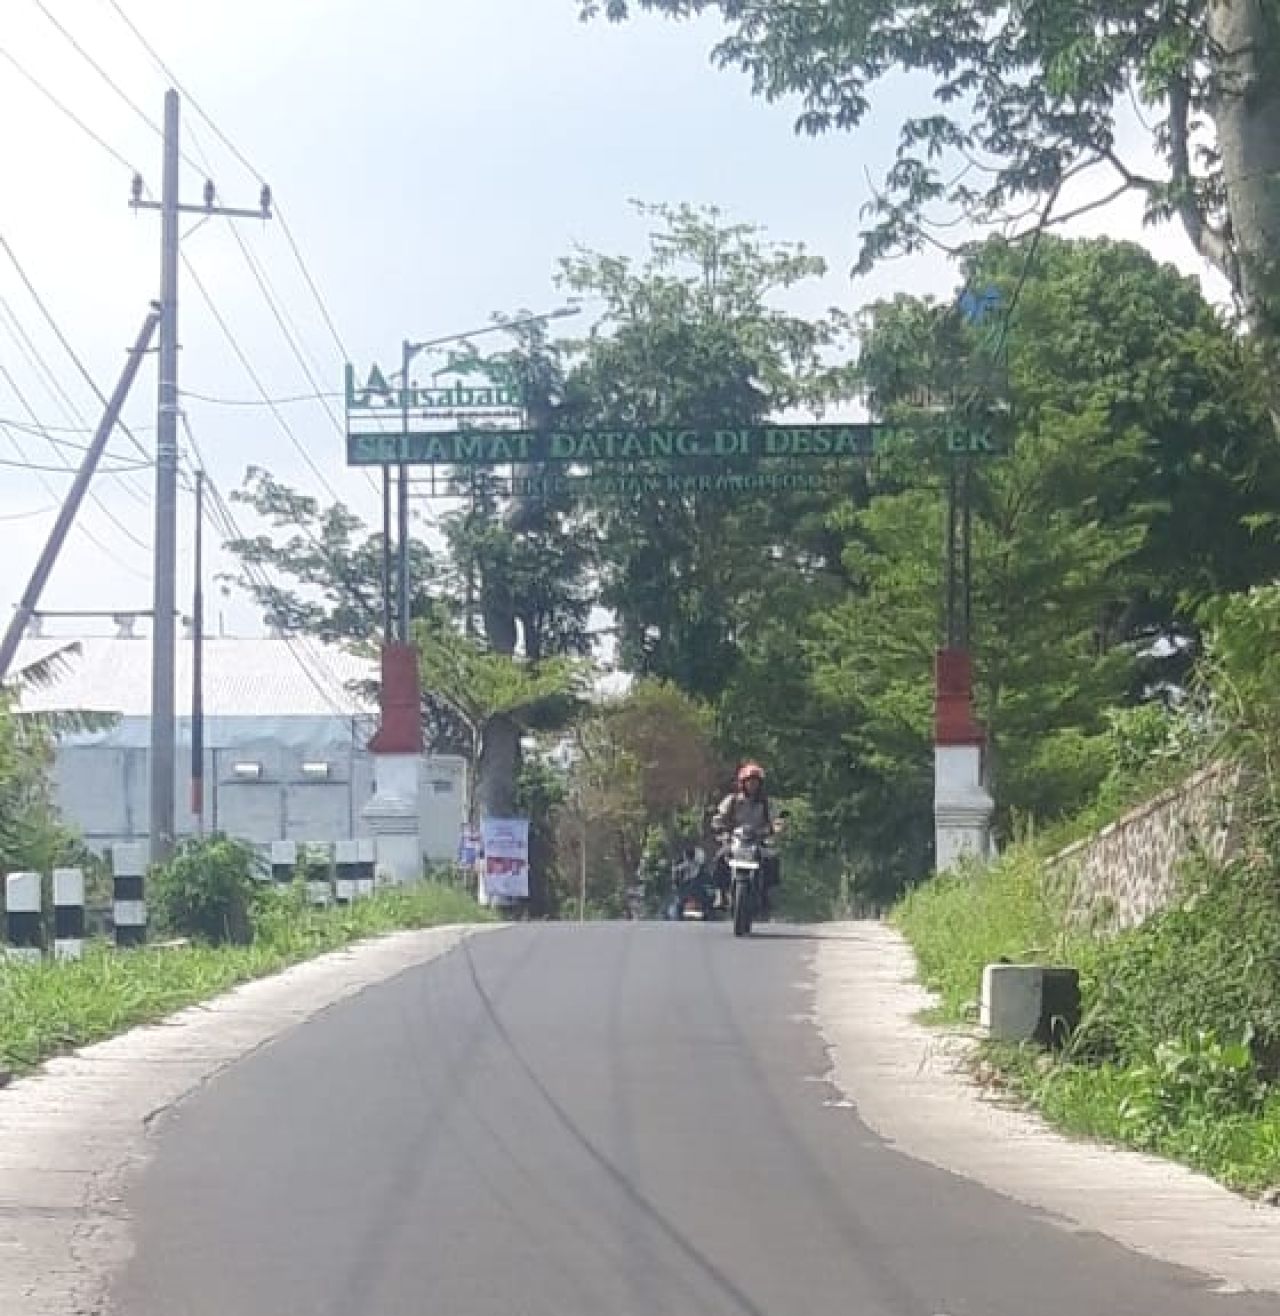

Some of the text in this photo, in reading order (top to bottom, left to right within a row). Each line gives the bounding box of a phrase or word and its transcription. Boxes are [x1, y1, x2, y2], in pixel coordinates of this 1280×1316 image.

[358, 434, 535, 459] SELAMAT
[551, 432, 698, 457] DATANG
[714, 430, 751, 454] DI
[766, 428, 857, 453] DESA
